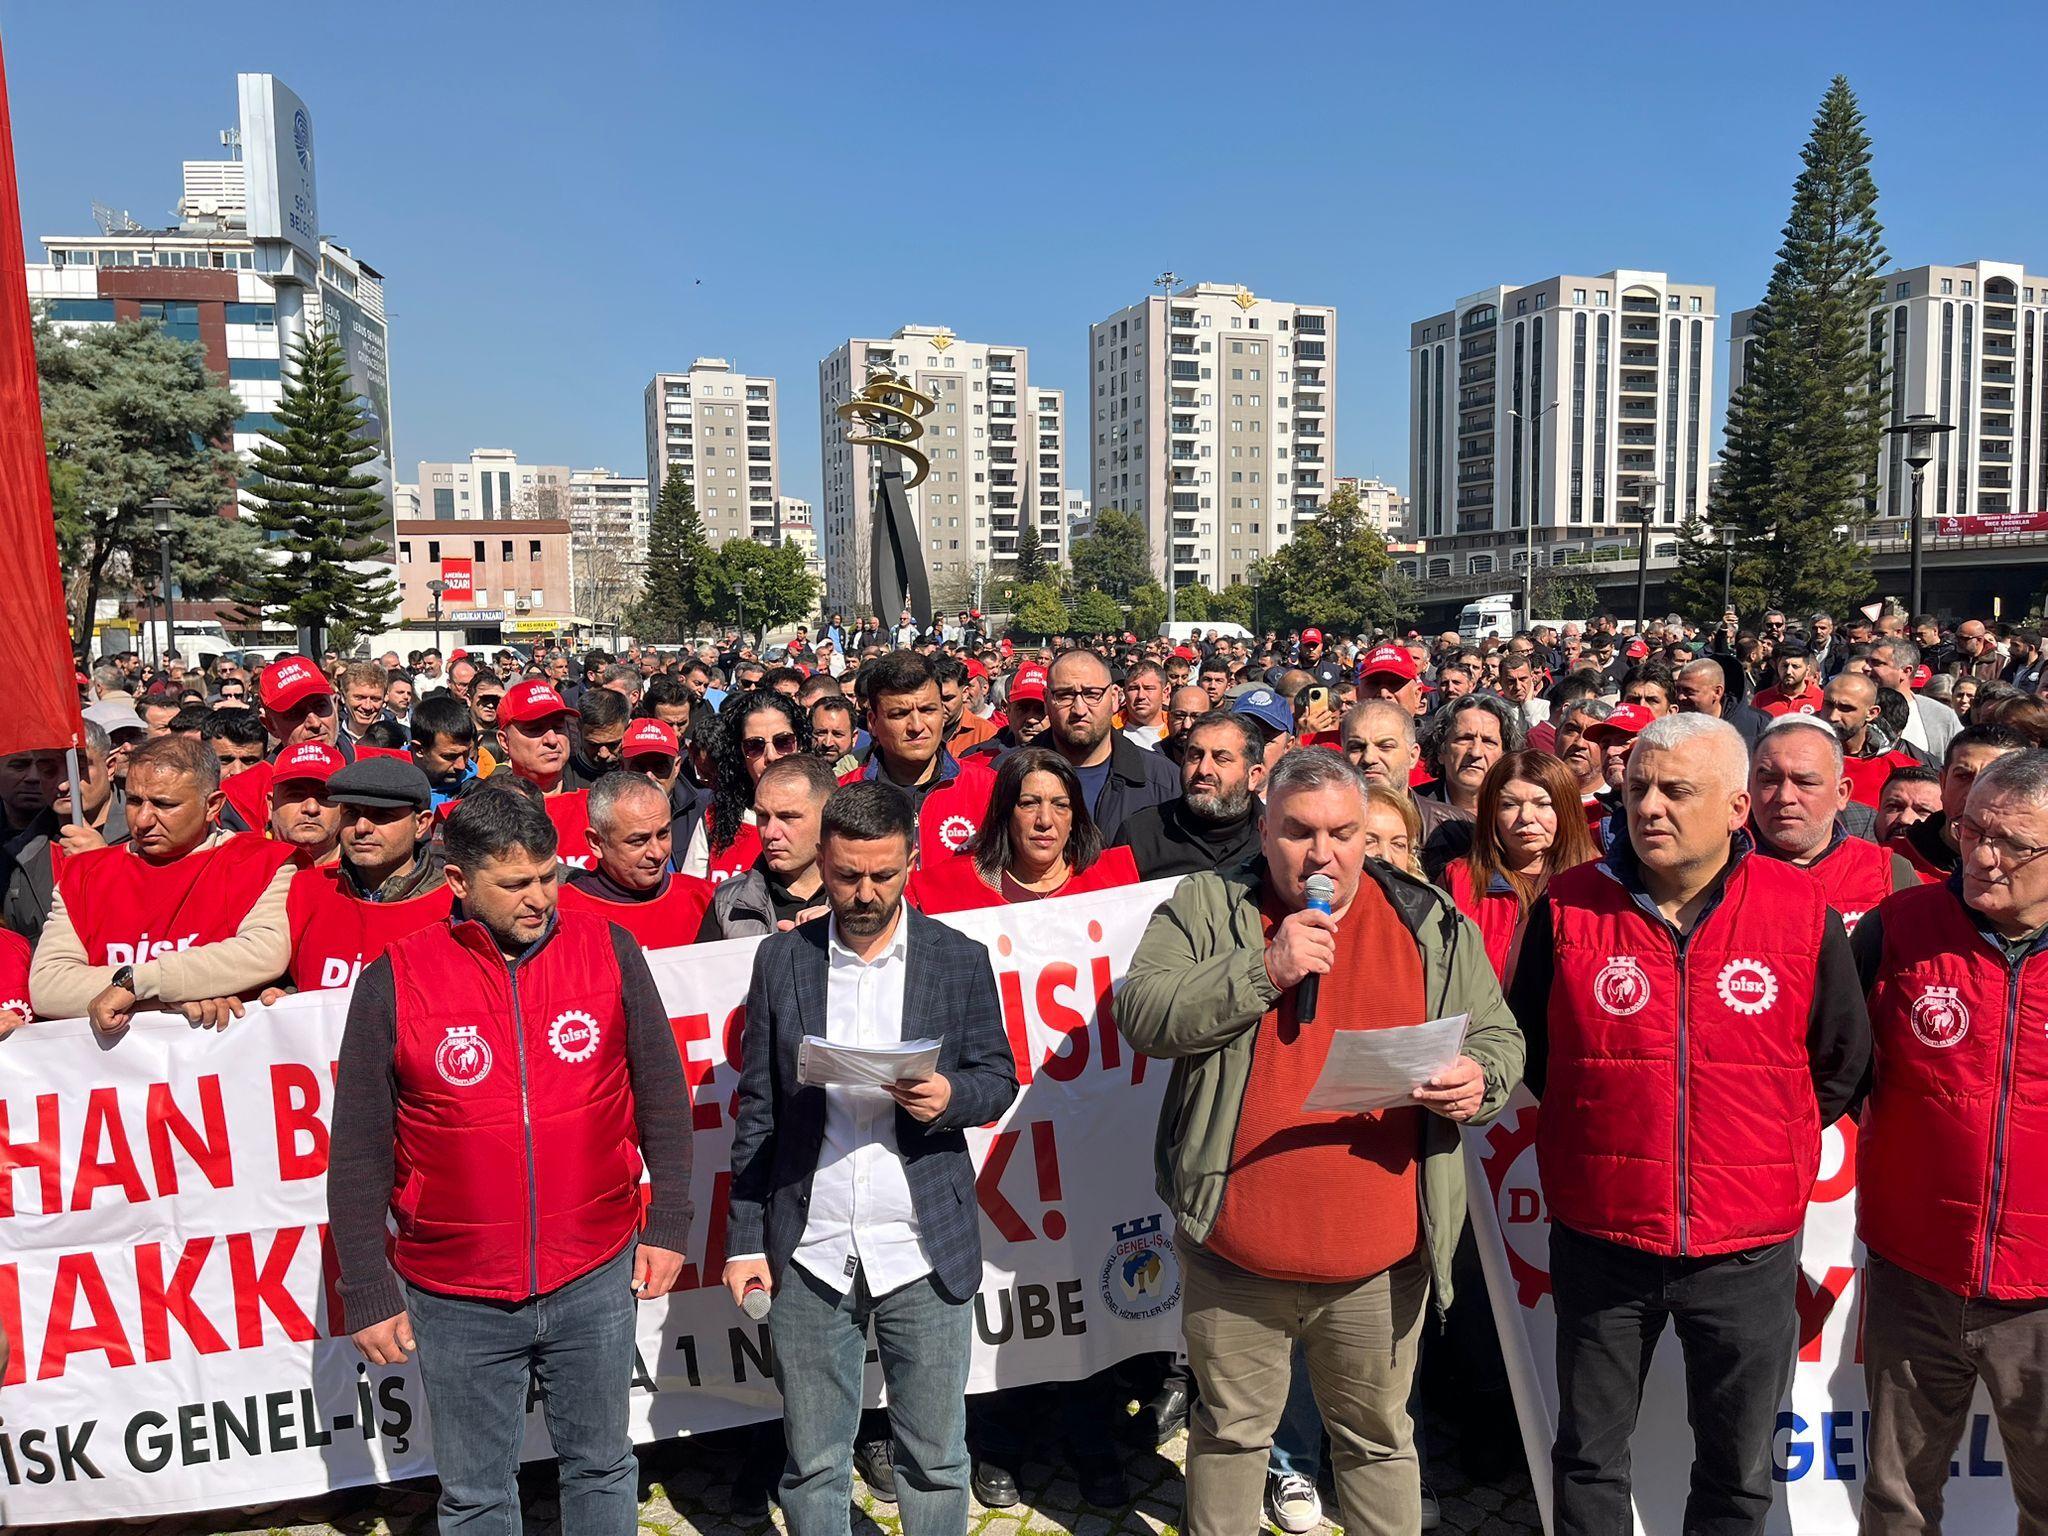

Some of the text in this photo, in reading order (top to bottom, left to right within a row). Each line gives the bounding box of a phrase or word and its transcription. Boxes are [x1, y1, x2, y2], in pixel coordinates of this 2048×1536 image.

[277, 663, 302, 679] DİSK
[277, 670, 311, 689] GENEL-İŞ
[529, 685, 551, 695] DİSK
[297, 745, 324, 755] DİSK
[291, 754, 331, 765] GENEL-İŞ
[1730, 976, 1765, 993] DİSK
[560, 1027, 590, 1045] DİSK
[0, 1073, 234, 1218] HAN
[1116, 1233, 1164, 1256] GENEL-İŞ
[0, 1417, 105, 1485] İSK
[124, 1361, 412, 1474] GENEL-İŞ
[974, 1280, 1087, 1346] UBE
